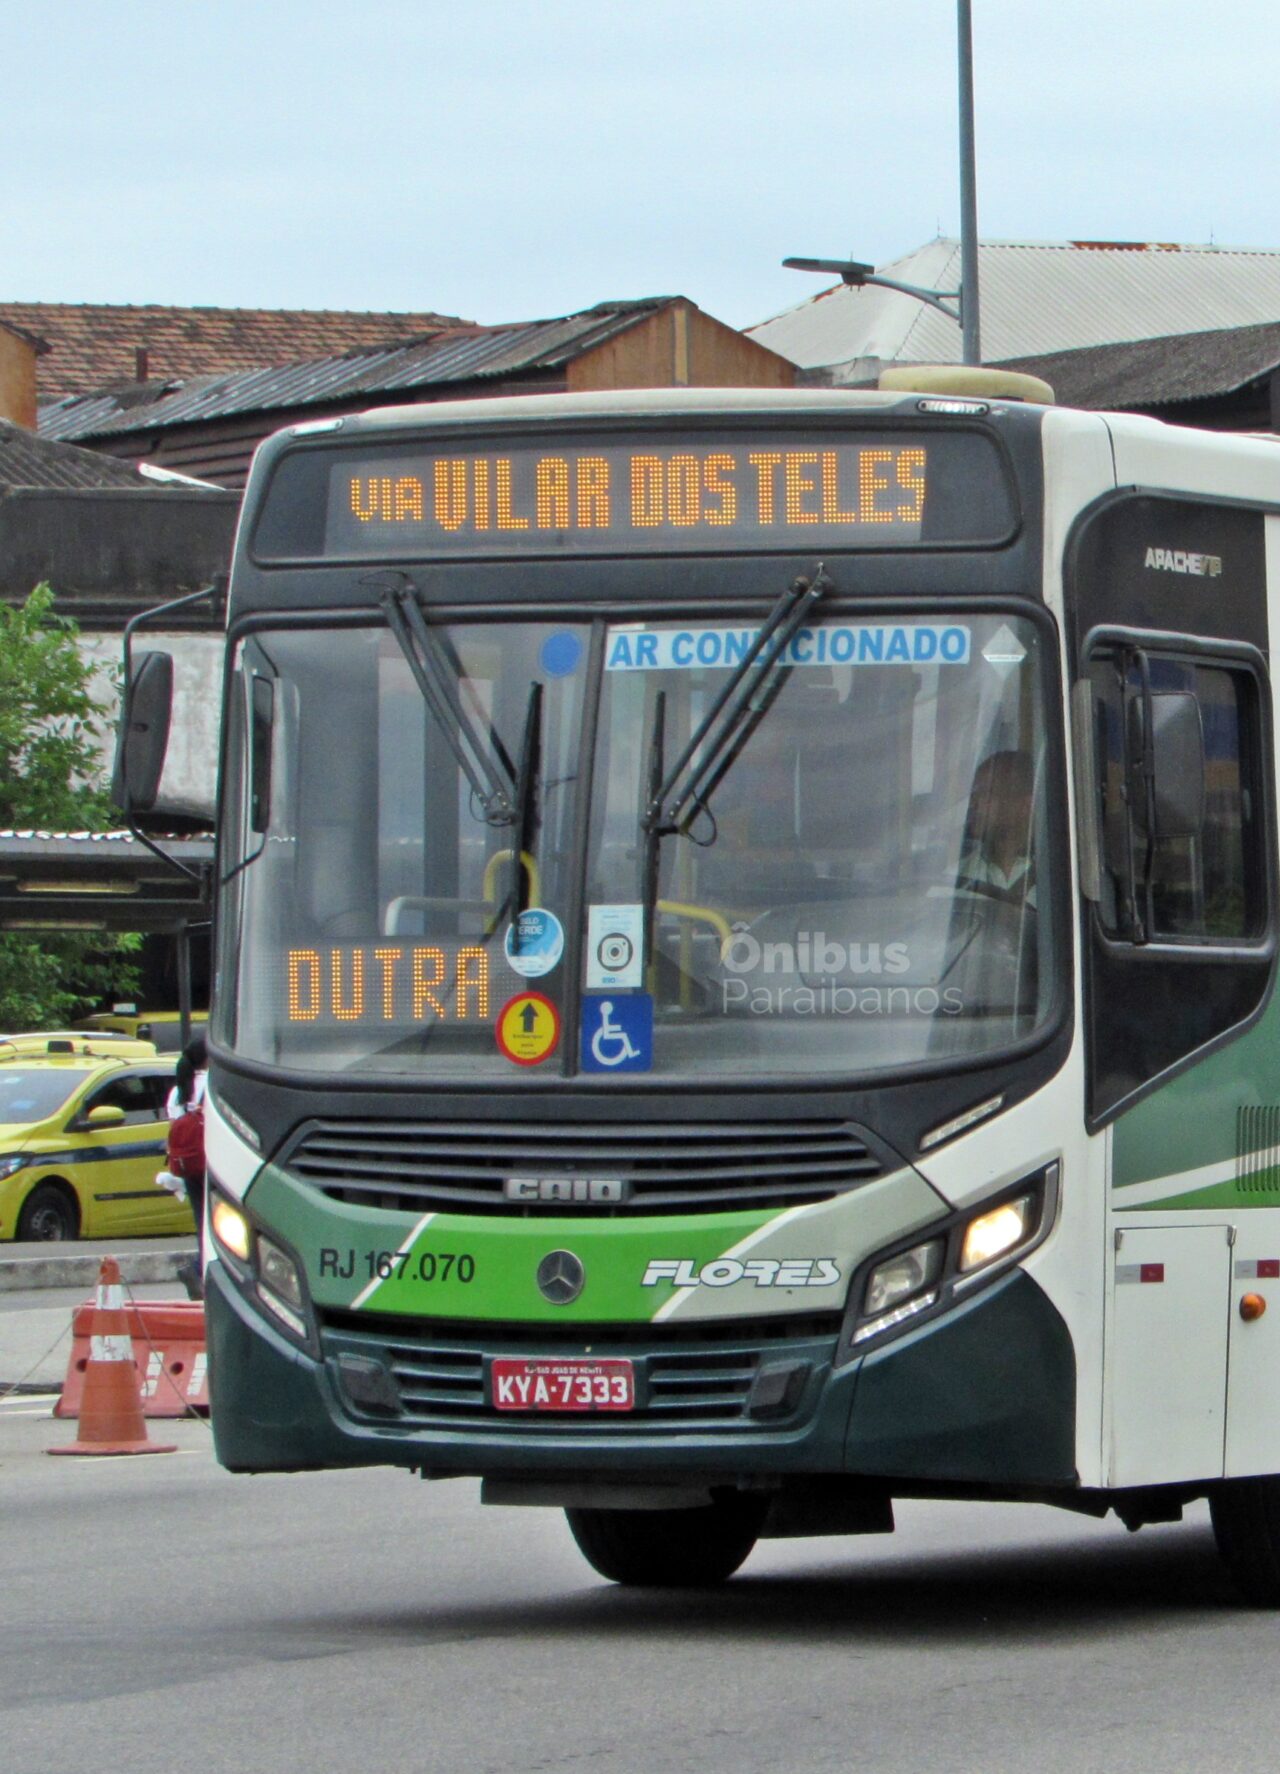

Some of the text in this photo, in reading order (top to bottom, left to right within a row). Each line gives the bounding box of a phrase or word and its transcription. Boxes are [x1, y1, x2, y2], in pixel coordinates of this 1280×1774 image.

[350, 450, 925, 530] VIA VILAR DOS TELES
[1144, 547, 1204, 575] APACHE
[609, 635, 659, 668] AR
[288, 947, 488, 1020] DUTRA
[505, 1179, 623, 1200] CAIO
[319, 1248, 475, 1283] RJ 167.070
[640, 1258, 841, 1287] FLORES
[498, 1375, 628, 1403] KYA-7333
